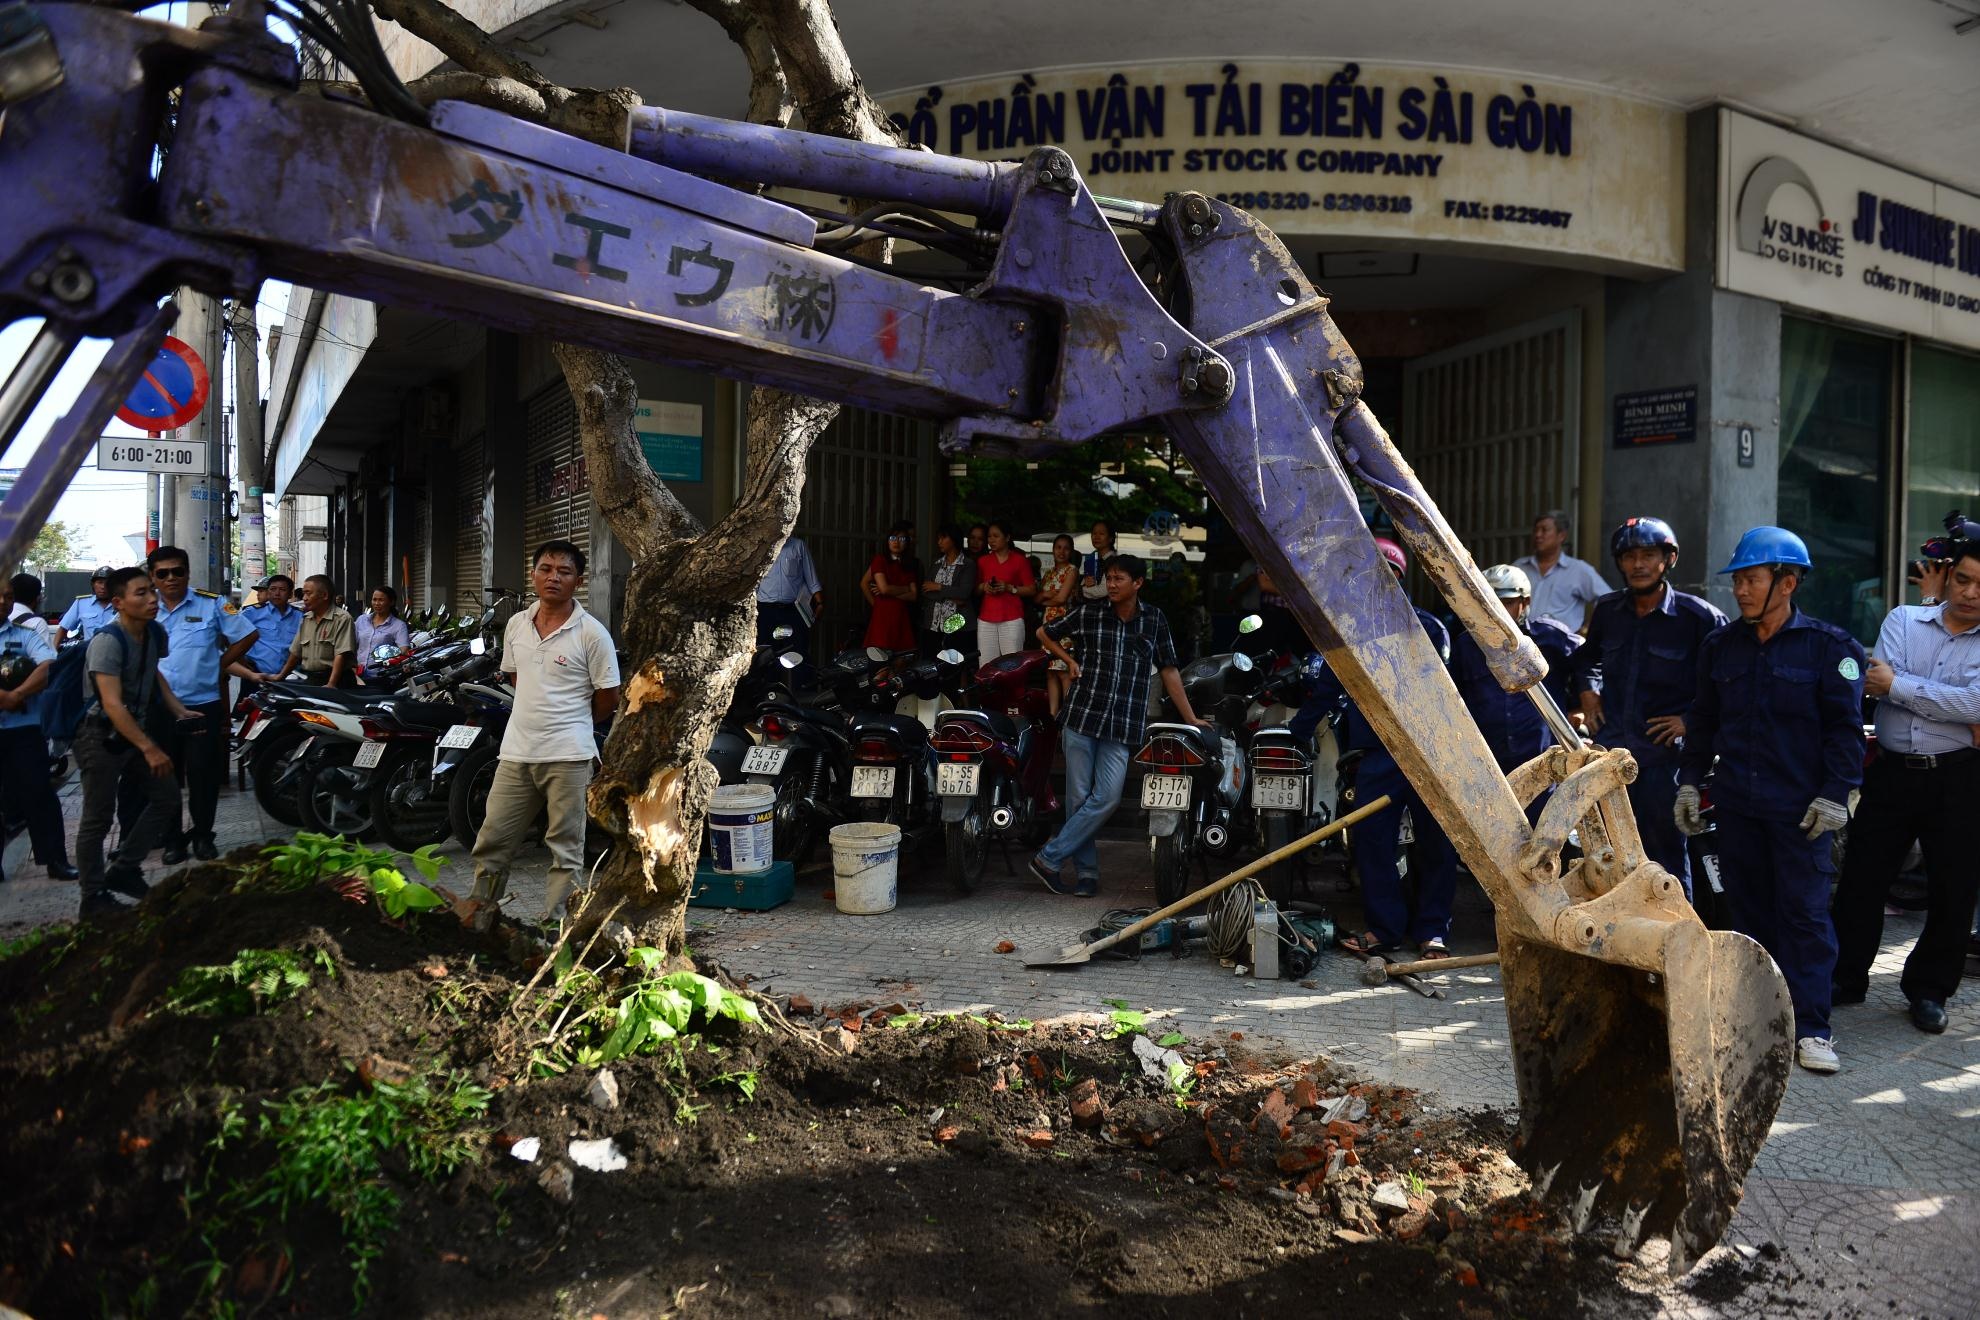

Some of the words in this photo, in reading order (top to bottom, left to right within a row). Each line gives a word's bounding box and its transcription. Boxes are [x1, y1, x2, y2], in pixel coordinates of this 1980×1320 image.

[949, 73, 1066, 154] PHẦN
[1076, 73, 1165, 148] VẬN
[1186, 63, 1262, 137] TẢI
[1279, 62, 1384, 140] BIỂN
[1397, 76, 1474, 145] SÀI
[1487, 84, 1573, 158] GÒN
[1088, 150, 1175, 175] JOINT
[1183, 148, 1288, 172] STOCK
[1296, 148, 1444, 178] COMPANY
[1779, 221, 1845, 259] SUNRISE
[1758, 240, 1844, 278] LOGISTICS
[1741, 429, 1752, 457] 9
[748, 760, 777, 773] 4887
[942, 780, 972, 793] 9676
[1149, 793, 1182, 806] 3770
